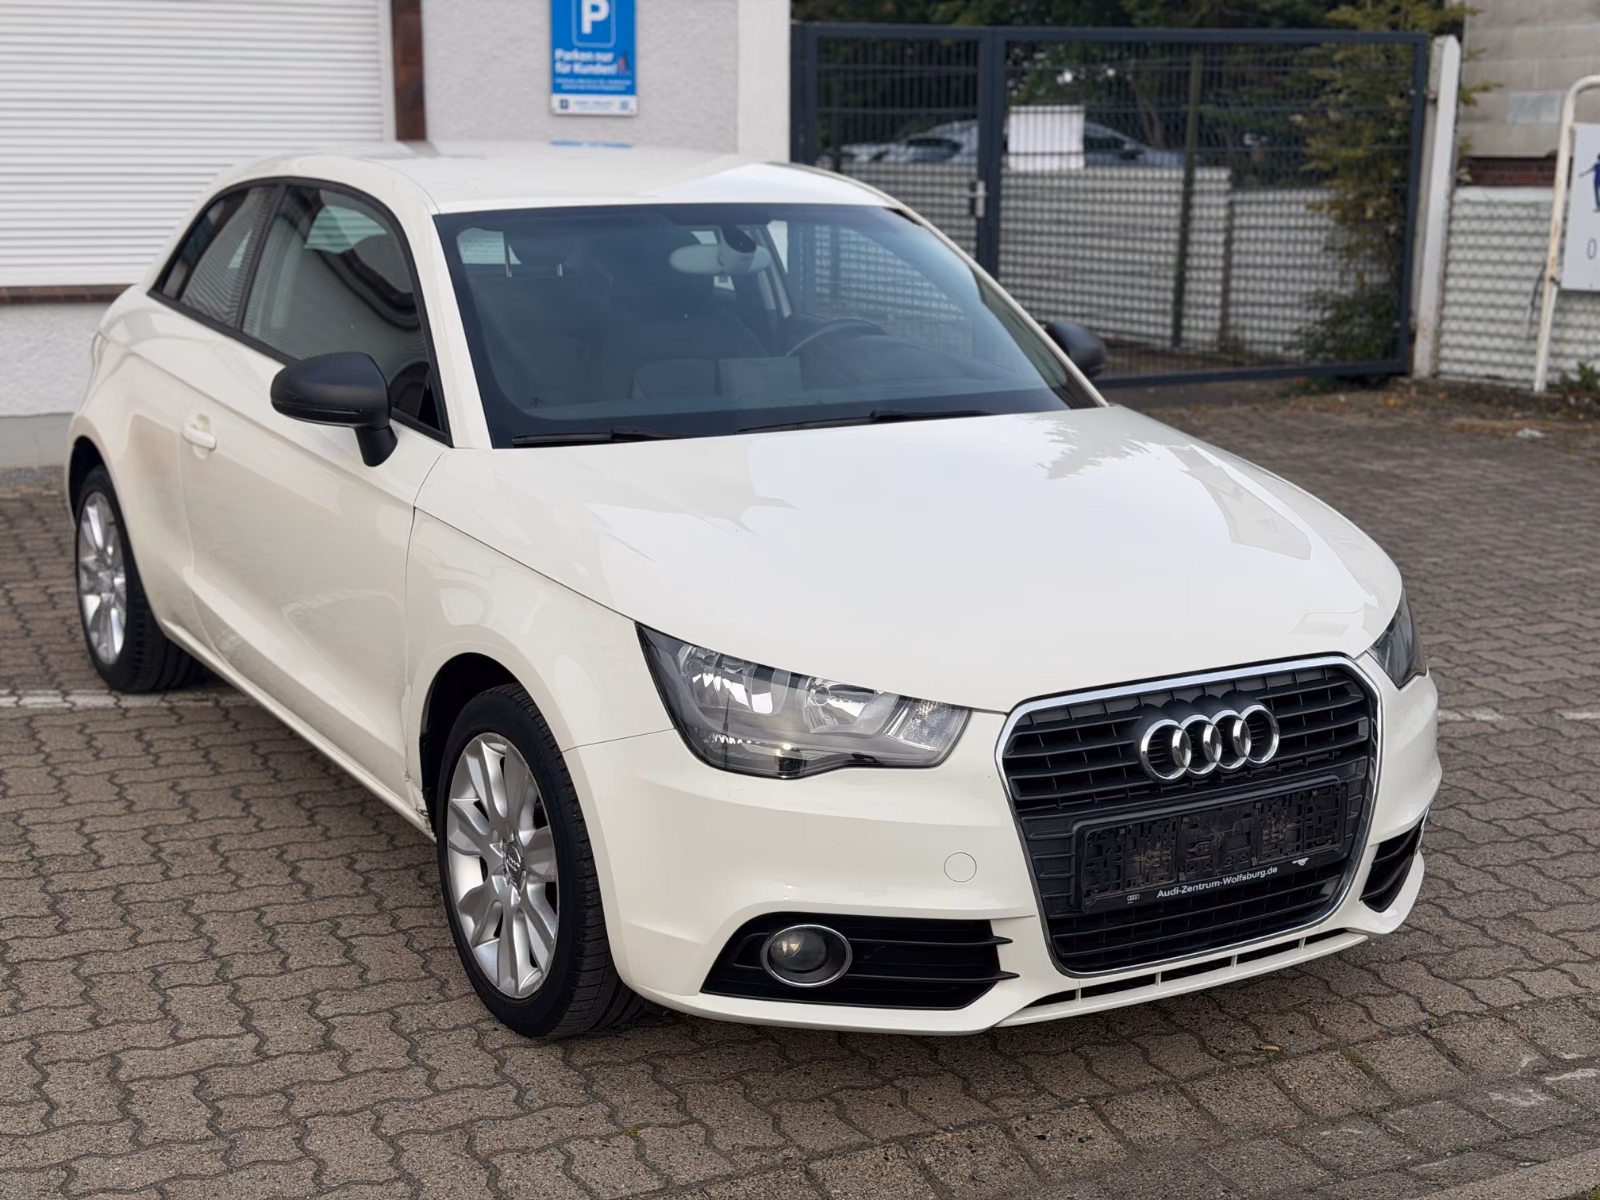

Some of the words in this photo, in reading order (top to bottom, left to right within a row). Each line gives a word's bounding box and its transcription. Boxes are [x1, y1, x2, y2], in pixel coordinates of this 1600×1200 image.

[581, 0, 610, 34] P
[554, 48, 593, 61] Parken
[595, 51, 614, 62] nur
[555, 61, 571, 74] für
[1156, 866, 1278, 898] Audi-Zentrum-Wolfsburg.de
